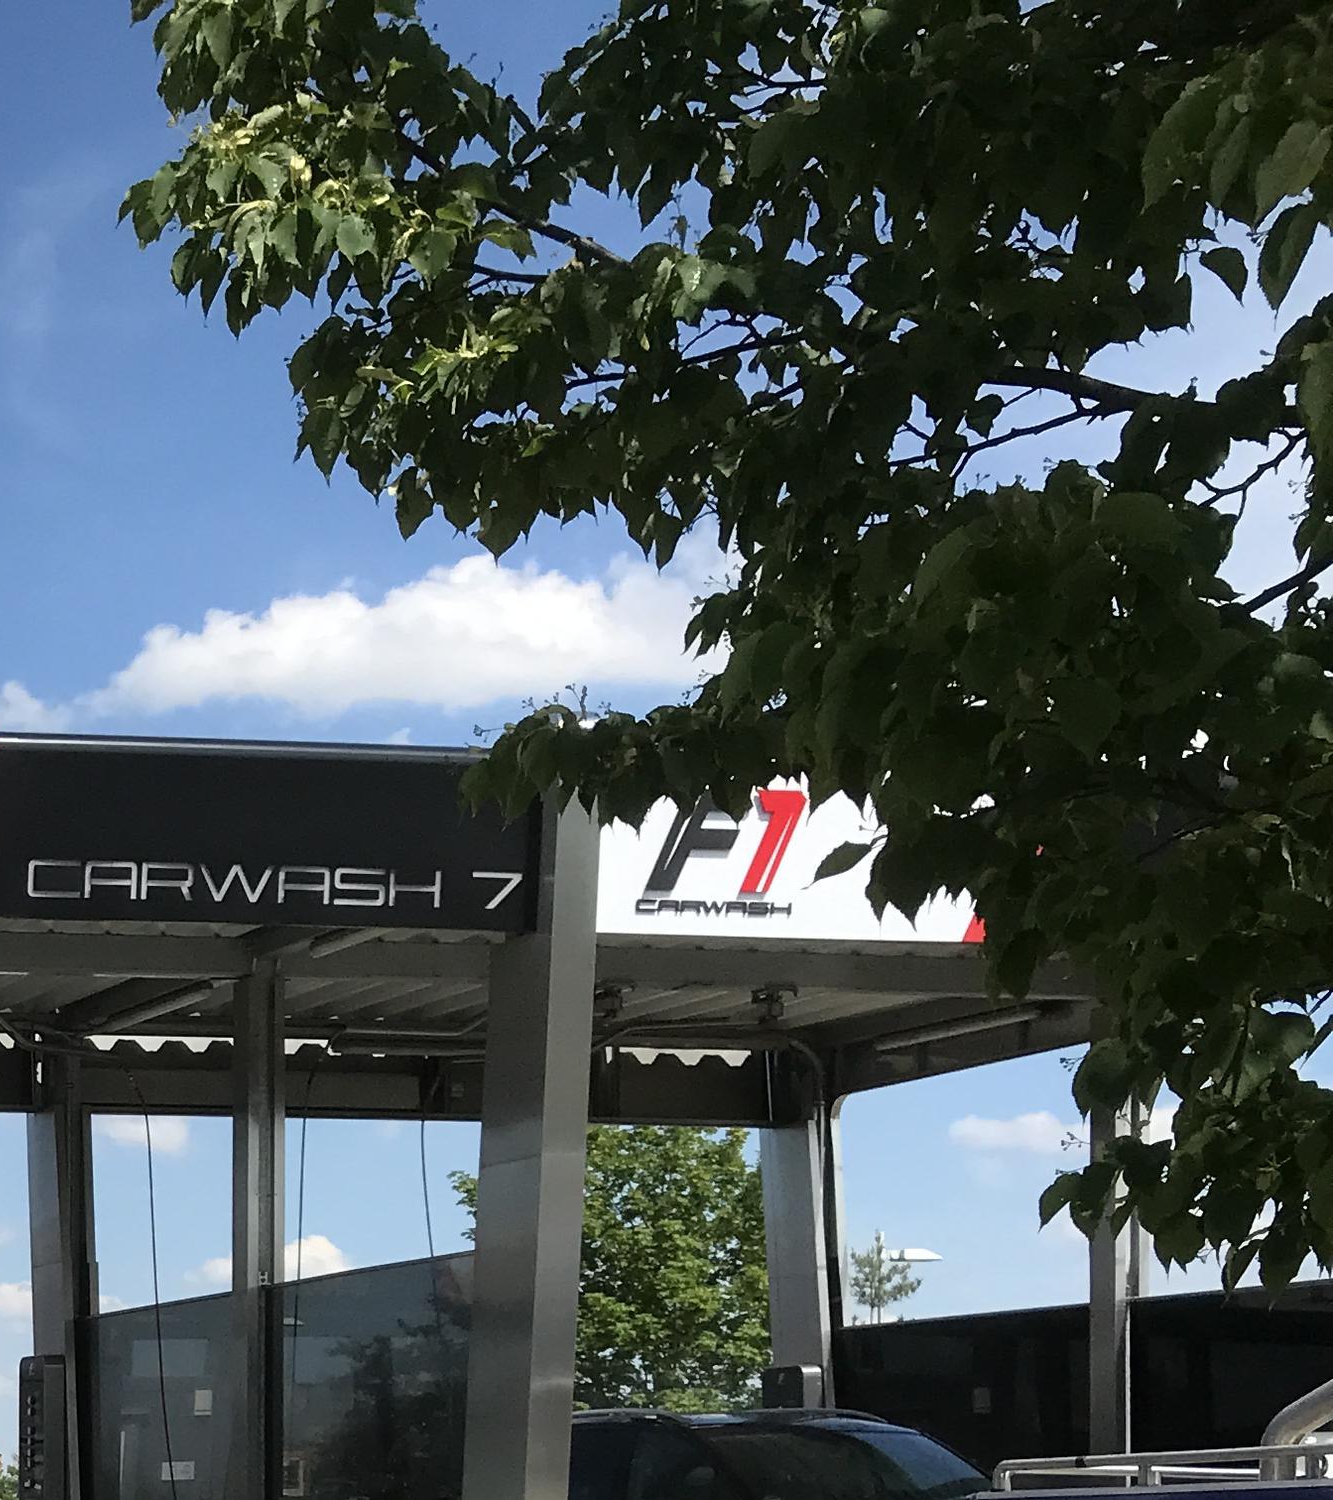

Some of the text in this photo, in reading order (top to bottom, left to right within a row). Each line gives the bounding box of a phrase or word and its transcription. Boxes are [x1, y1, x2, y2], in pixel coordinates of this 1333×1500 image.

[26, 858, 524, 911] CARWASH 7
[634, 898, 793, 917] CARWASH
